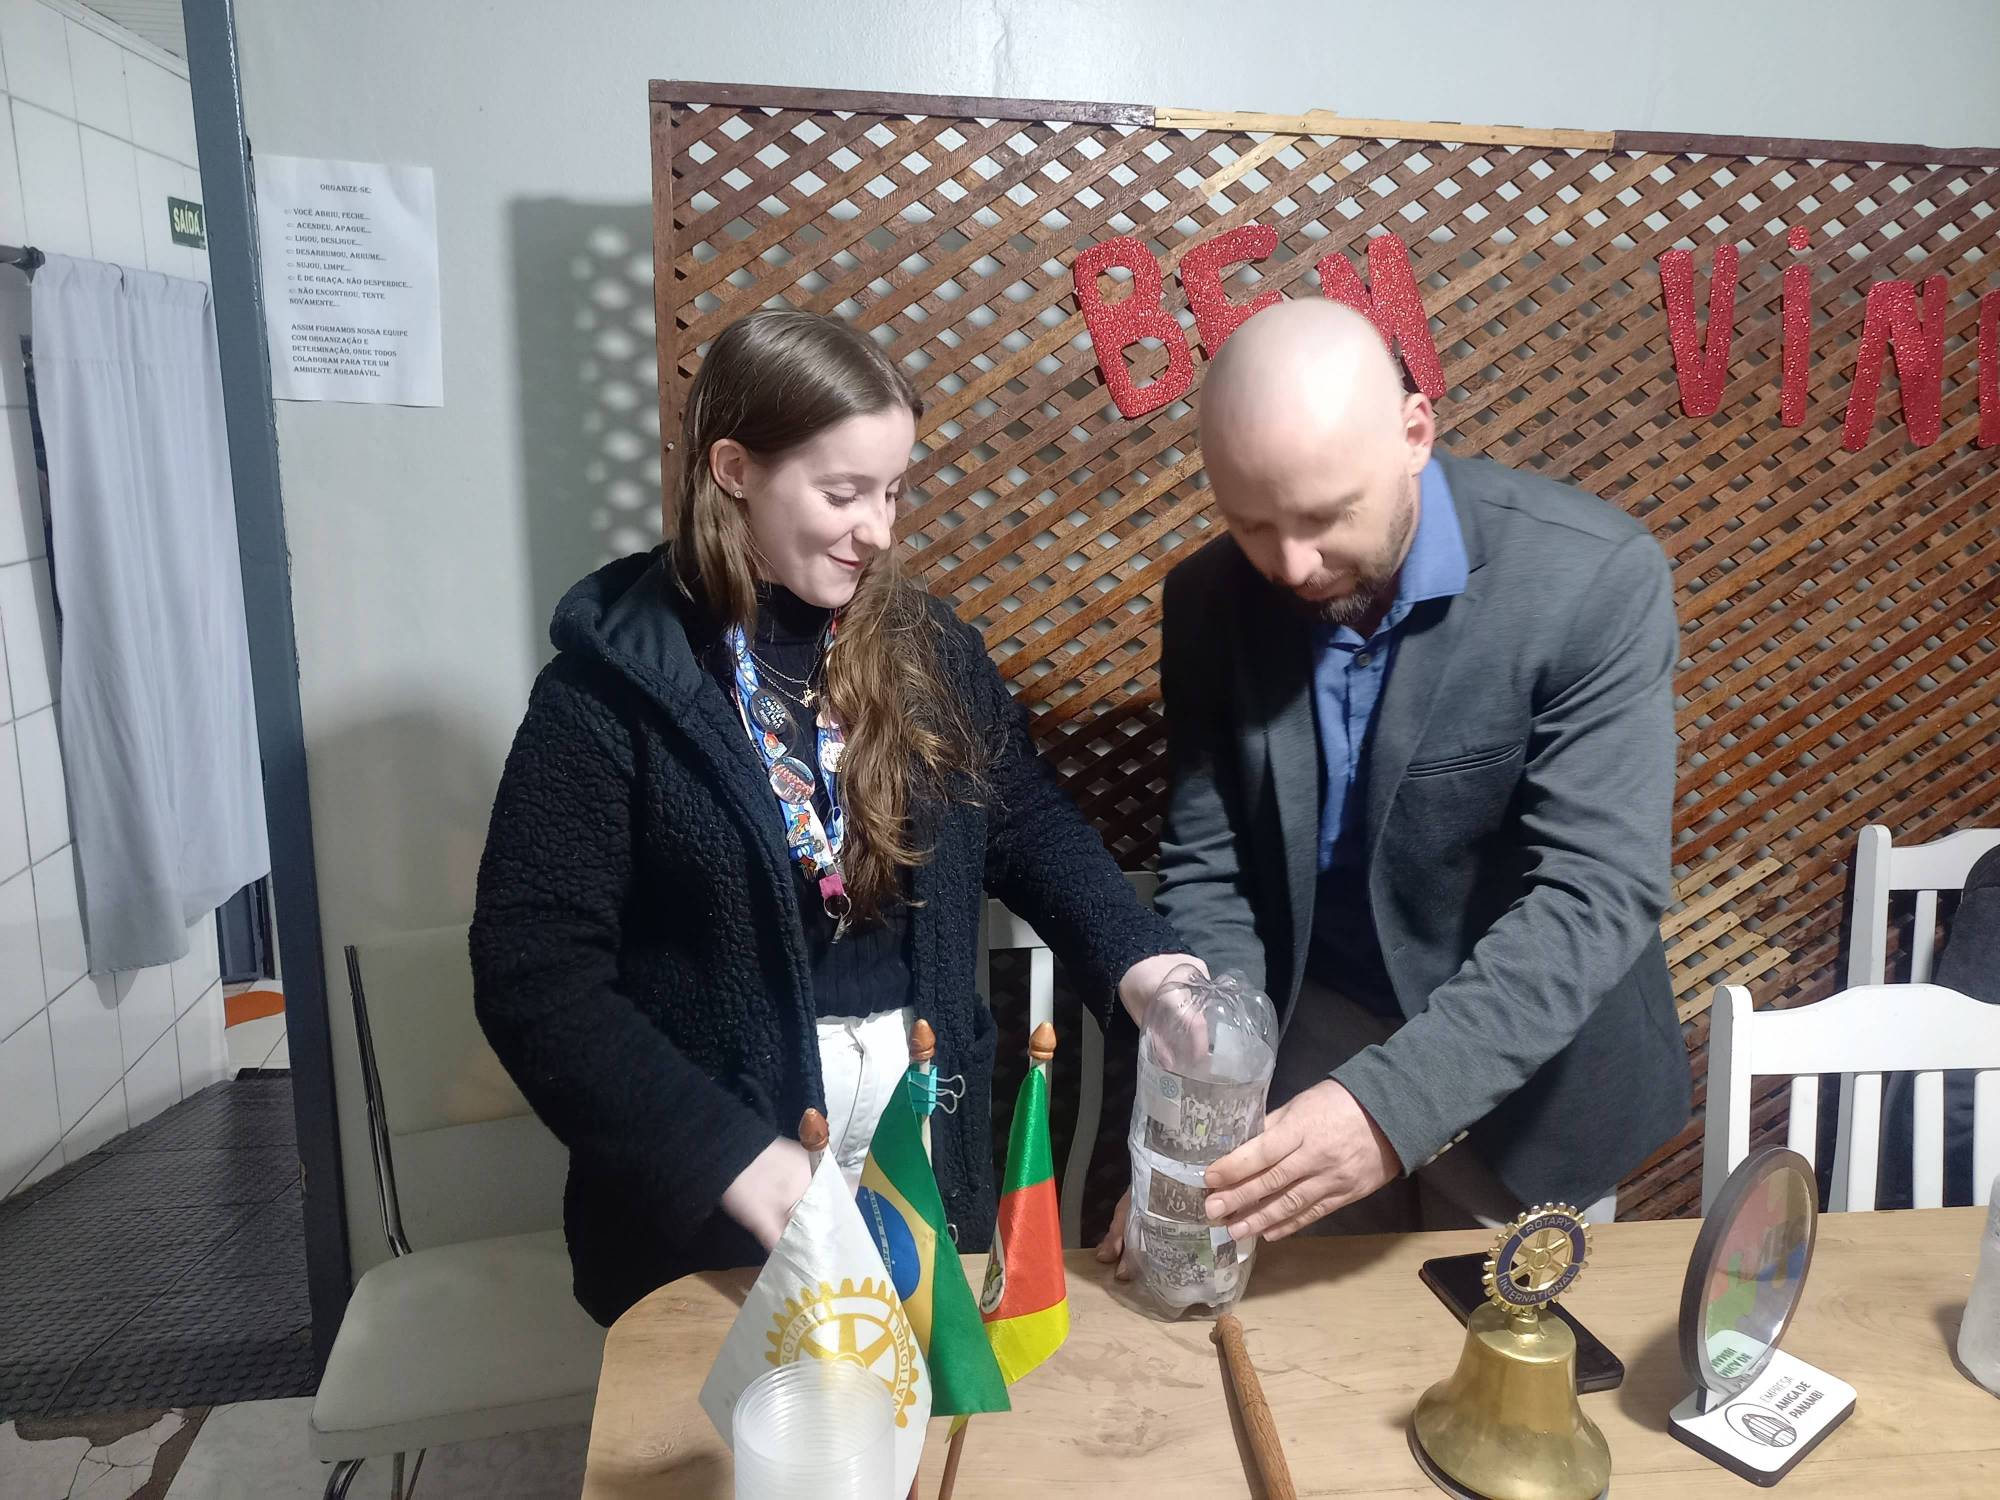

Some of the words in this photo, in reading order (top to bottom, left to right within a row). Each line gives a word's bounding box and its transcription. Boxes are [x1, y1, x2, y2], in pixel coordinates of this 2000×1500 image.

[173, 204, 201, 236] SAÍDA
[293, 207, 313, 216] VOCÊ
[314, 210, 341, 220] ABRIU,
[296, 221, 334, 232] ACENDEU,
[295, 235, 320, 244] LIGOU,
[296, 262, 322, 270] SUJOU,
[304, 275, 314, 283] DE
[346, 277, 362, 285] NÃO
[298, 287, 314, 295] NÃO
[291, 323, 314, 331] ASSIM
[315, 325, 356, 334] FORMAMOS
[357, 328, 381, 336] NOSSA
[382, 329, 409, 337] EQUIPE
[291, 334, 308, 342] COM
[308, 335, 363, 346] ORGANIZAÇÃO
[1074, 225, 1446, 418] BEM
[1658, 225, 2000, 452] ViN
[352, 348, 372, 356] ONDE
[292, 355, 339, 364] COLABORAM
[340, 358, 361, 366] PARA
[293, 365, 332, 374] AMBIENTE
[1526, 1217, 1571, 1233] ROTARY
[1500, 1270, 1576, 1303] INTERNATIONAL
[782, 1307, 818, 1364] ROTARY
[1760, 1375, 1795, 1403] EMPRESA
[1775, 1389, 1803, 1412] AMIGA
[1798, 1380, 1812, 1393] DE
[1788, 1389, 1826, 1419] PANAMBI
